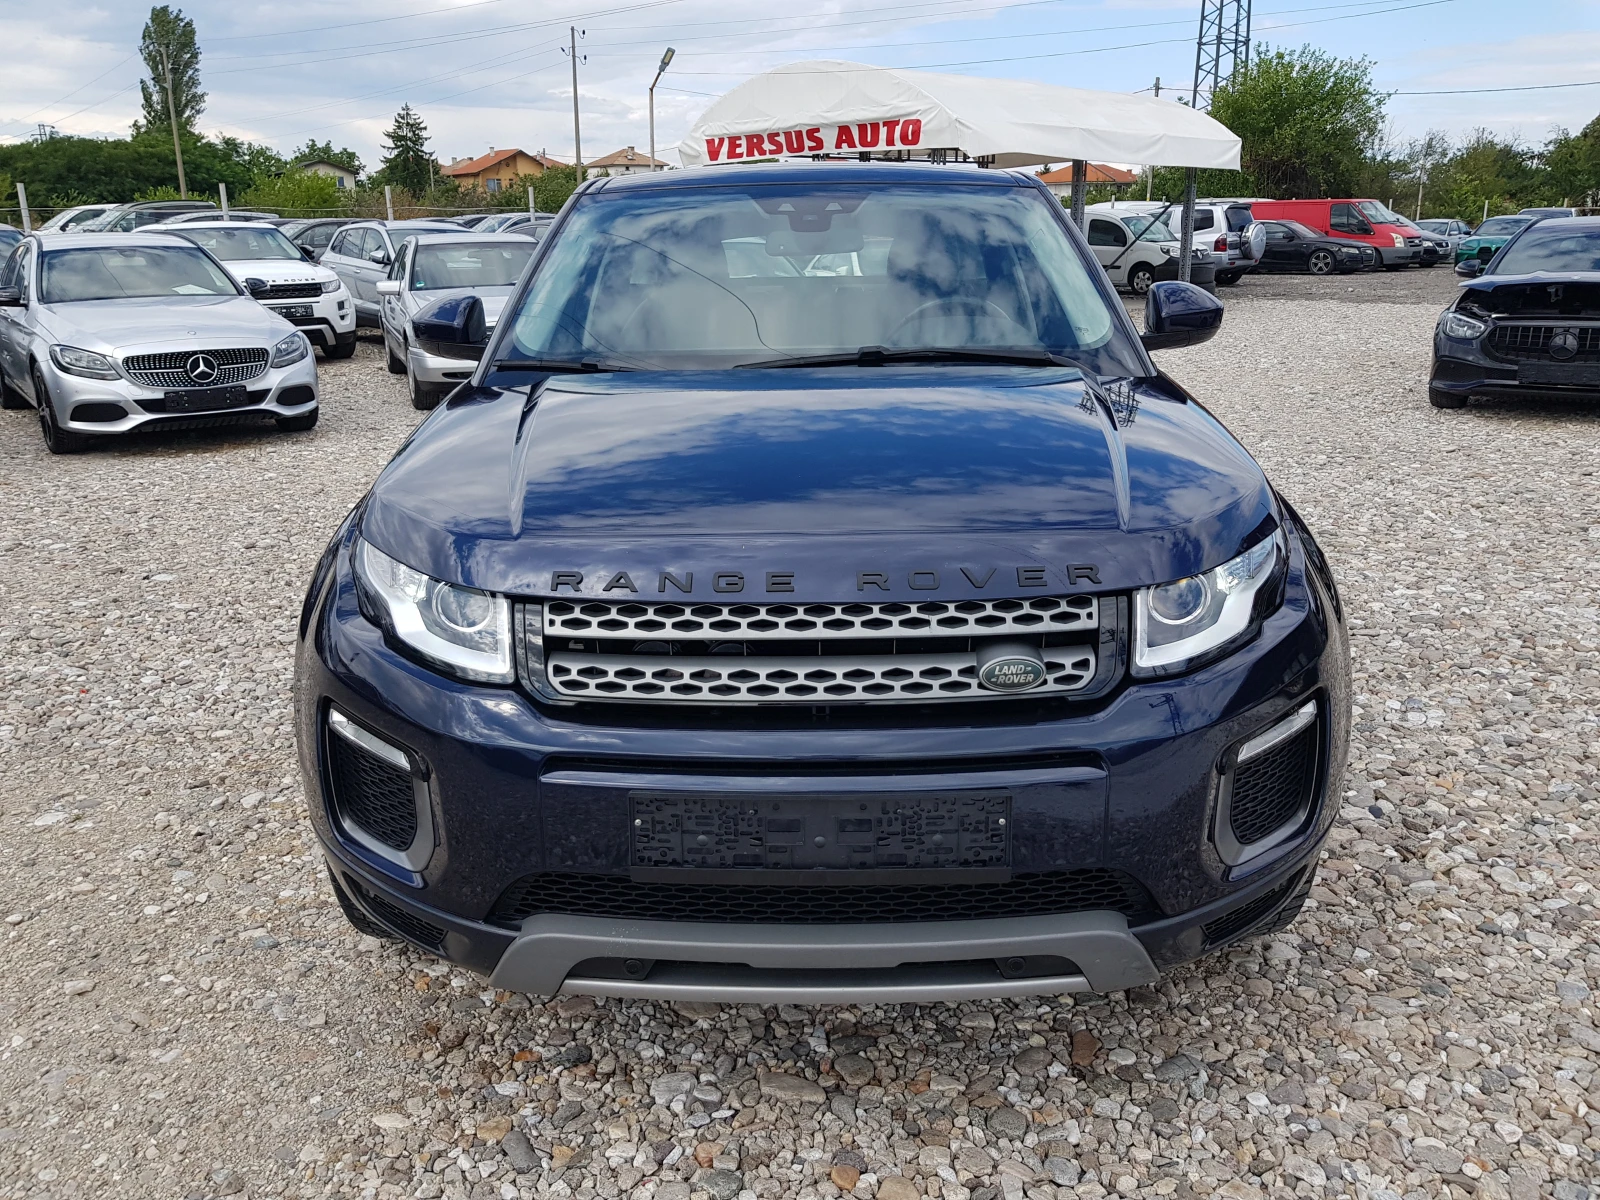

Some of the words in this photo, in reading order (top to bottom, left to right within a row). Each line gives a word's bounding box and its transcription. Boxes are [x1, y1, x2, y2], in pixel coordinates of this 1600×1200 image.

[705, 127, 824, 162] VERSUS
[835, 118, 922, 149] AUTO
[550, 570, 795, 593] RANGE
[856, 563, 1102, 591] ROVER
[994, 665, 1025, 675] LAND
[997, 674, 1034, 684] ROVER
